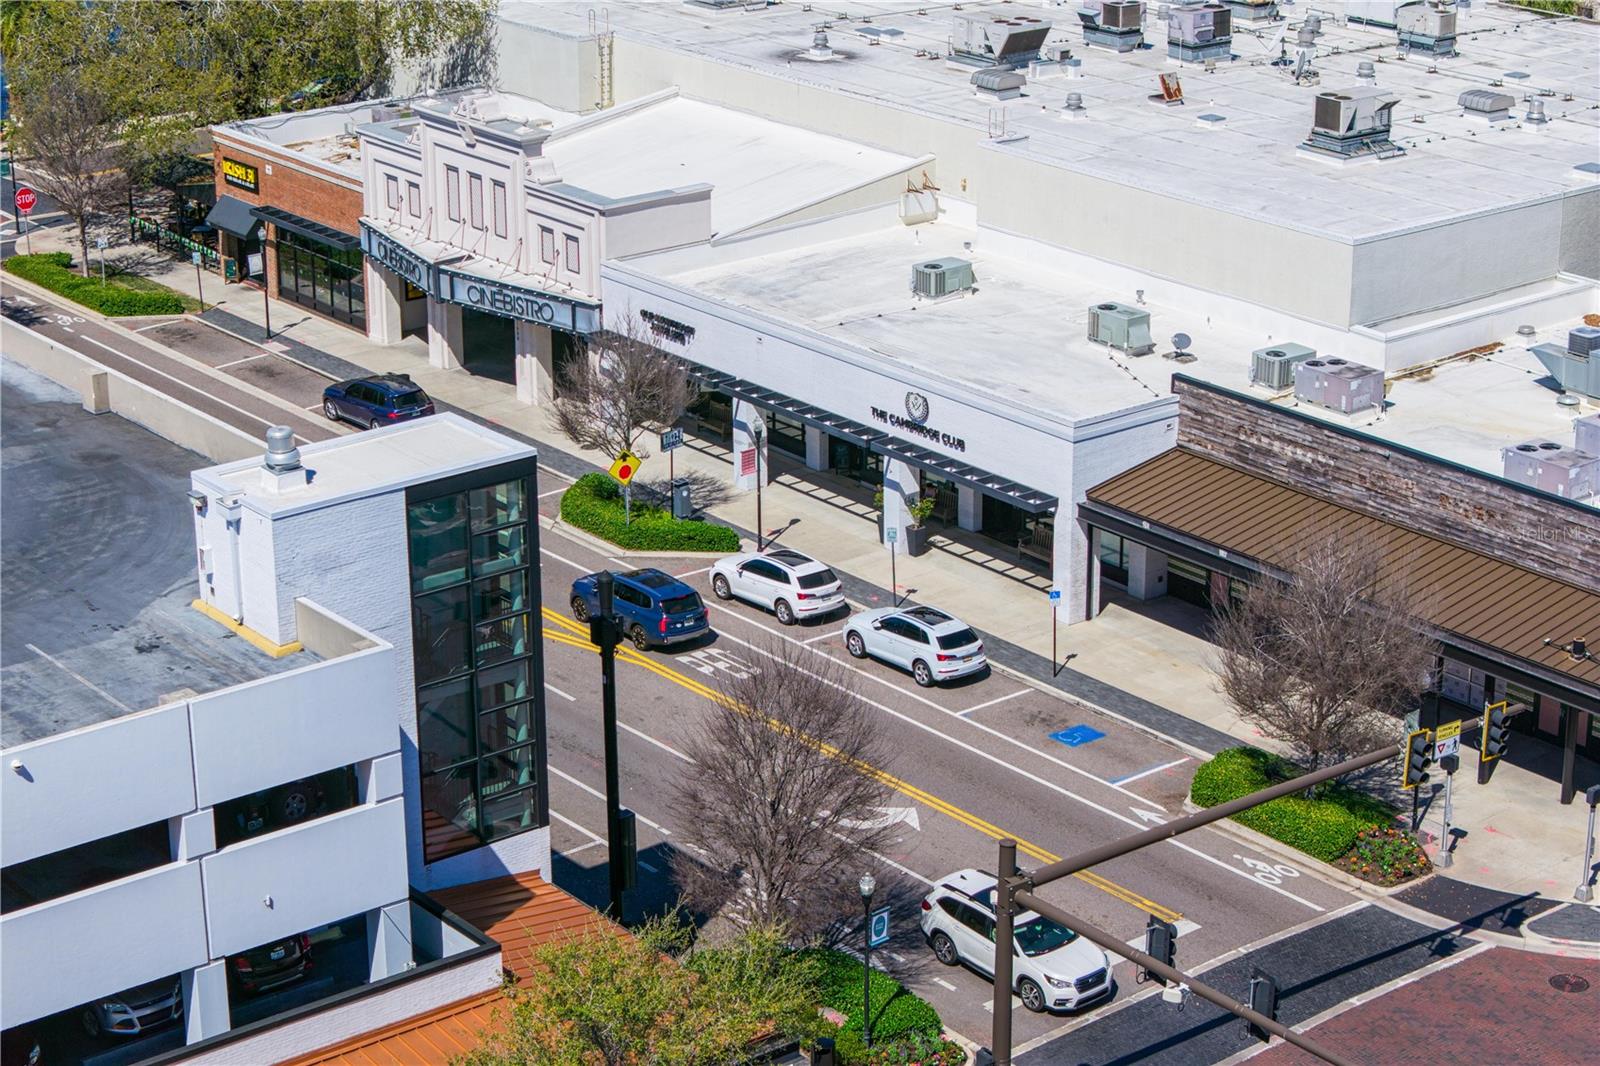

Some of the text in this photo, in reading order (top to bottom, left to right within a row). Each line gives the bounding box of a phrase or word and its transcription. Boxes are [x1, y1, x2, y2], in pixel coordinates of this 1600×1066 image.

[16, 193, 35, 205] STOP
[870, 406, 966, 452] THE CAMBRIDGE CLUB
